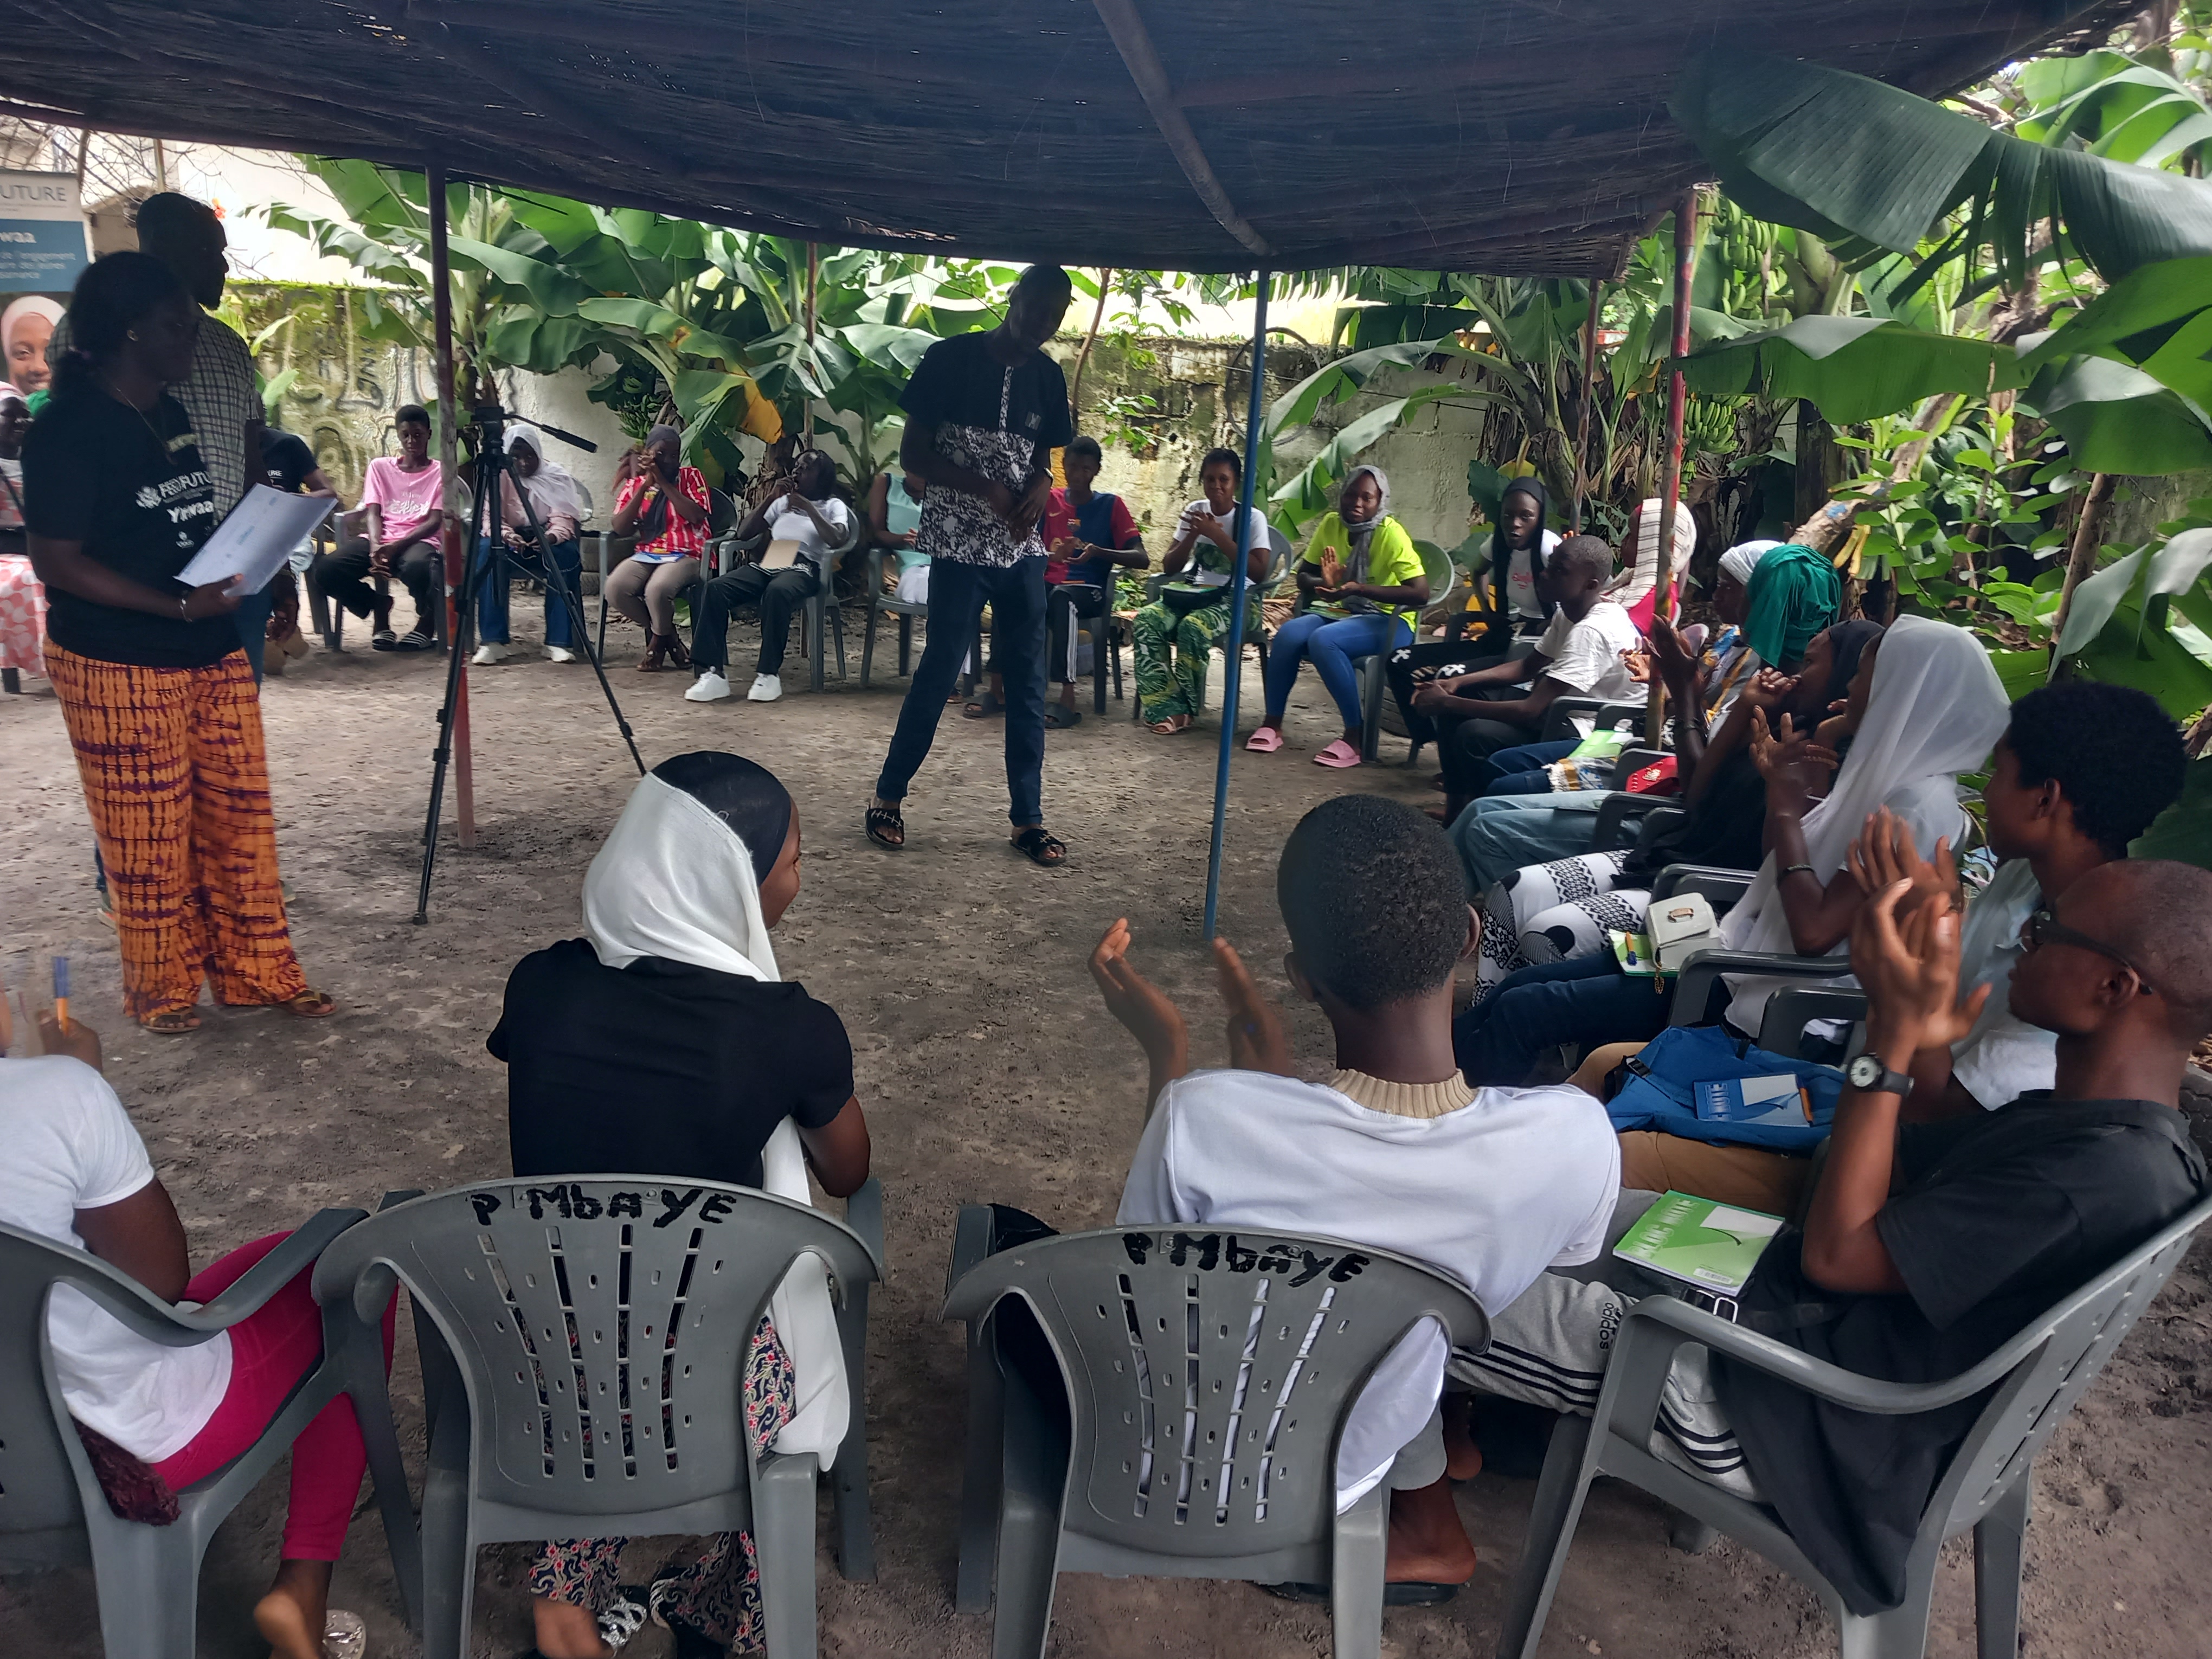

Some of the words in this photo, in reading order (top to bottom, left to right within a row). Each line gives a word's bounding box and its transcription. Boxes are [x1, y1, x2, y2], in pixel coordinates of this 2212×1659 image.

[0, 185, 67, 202] UTURE
[1628, 1224, 1674, 1259] BLOC
[1656, 1199, 1700, 1226] NOTE
